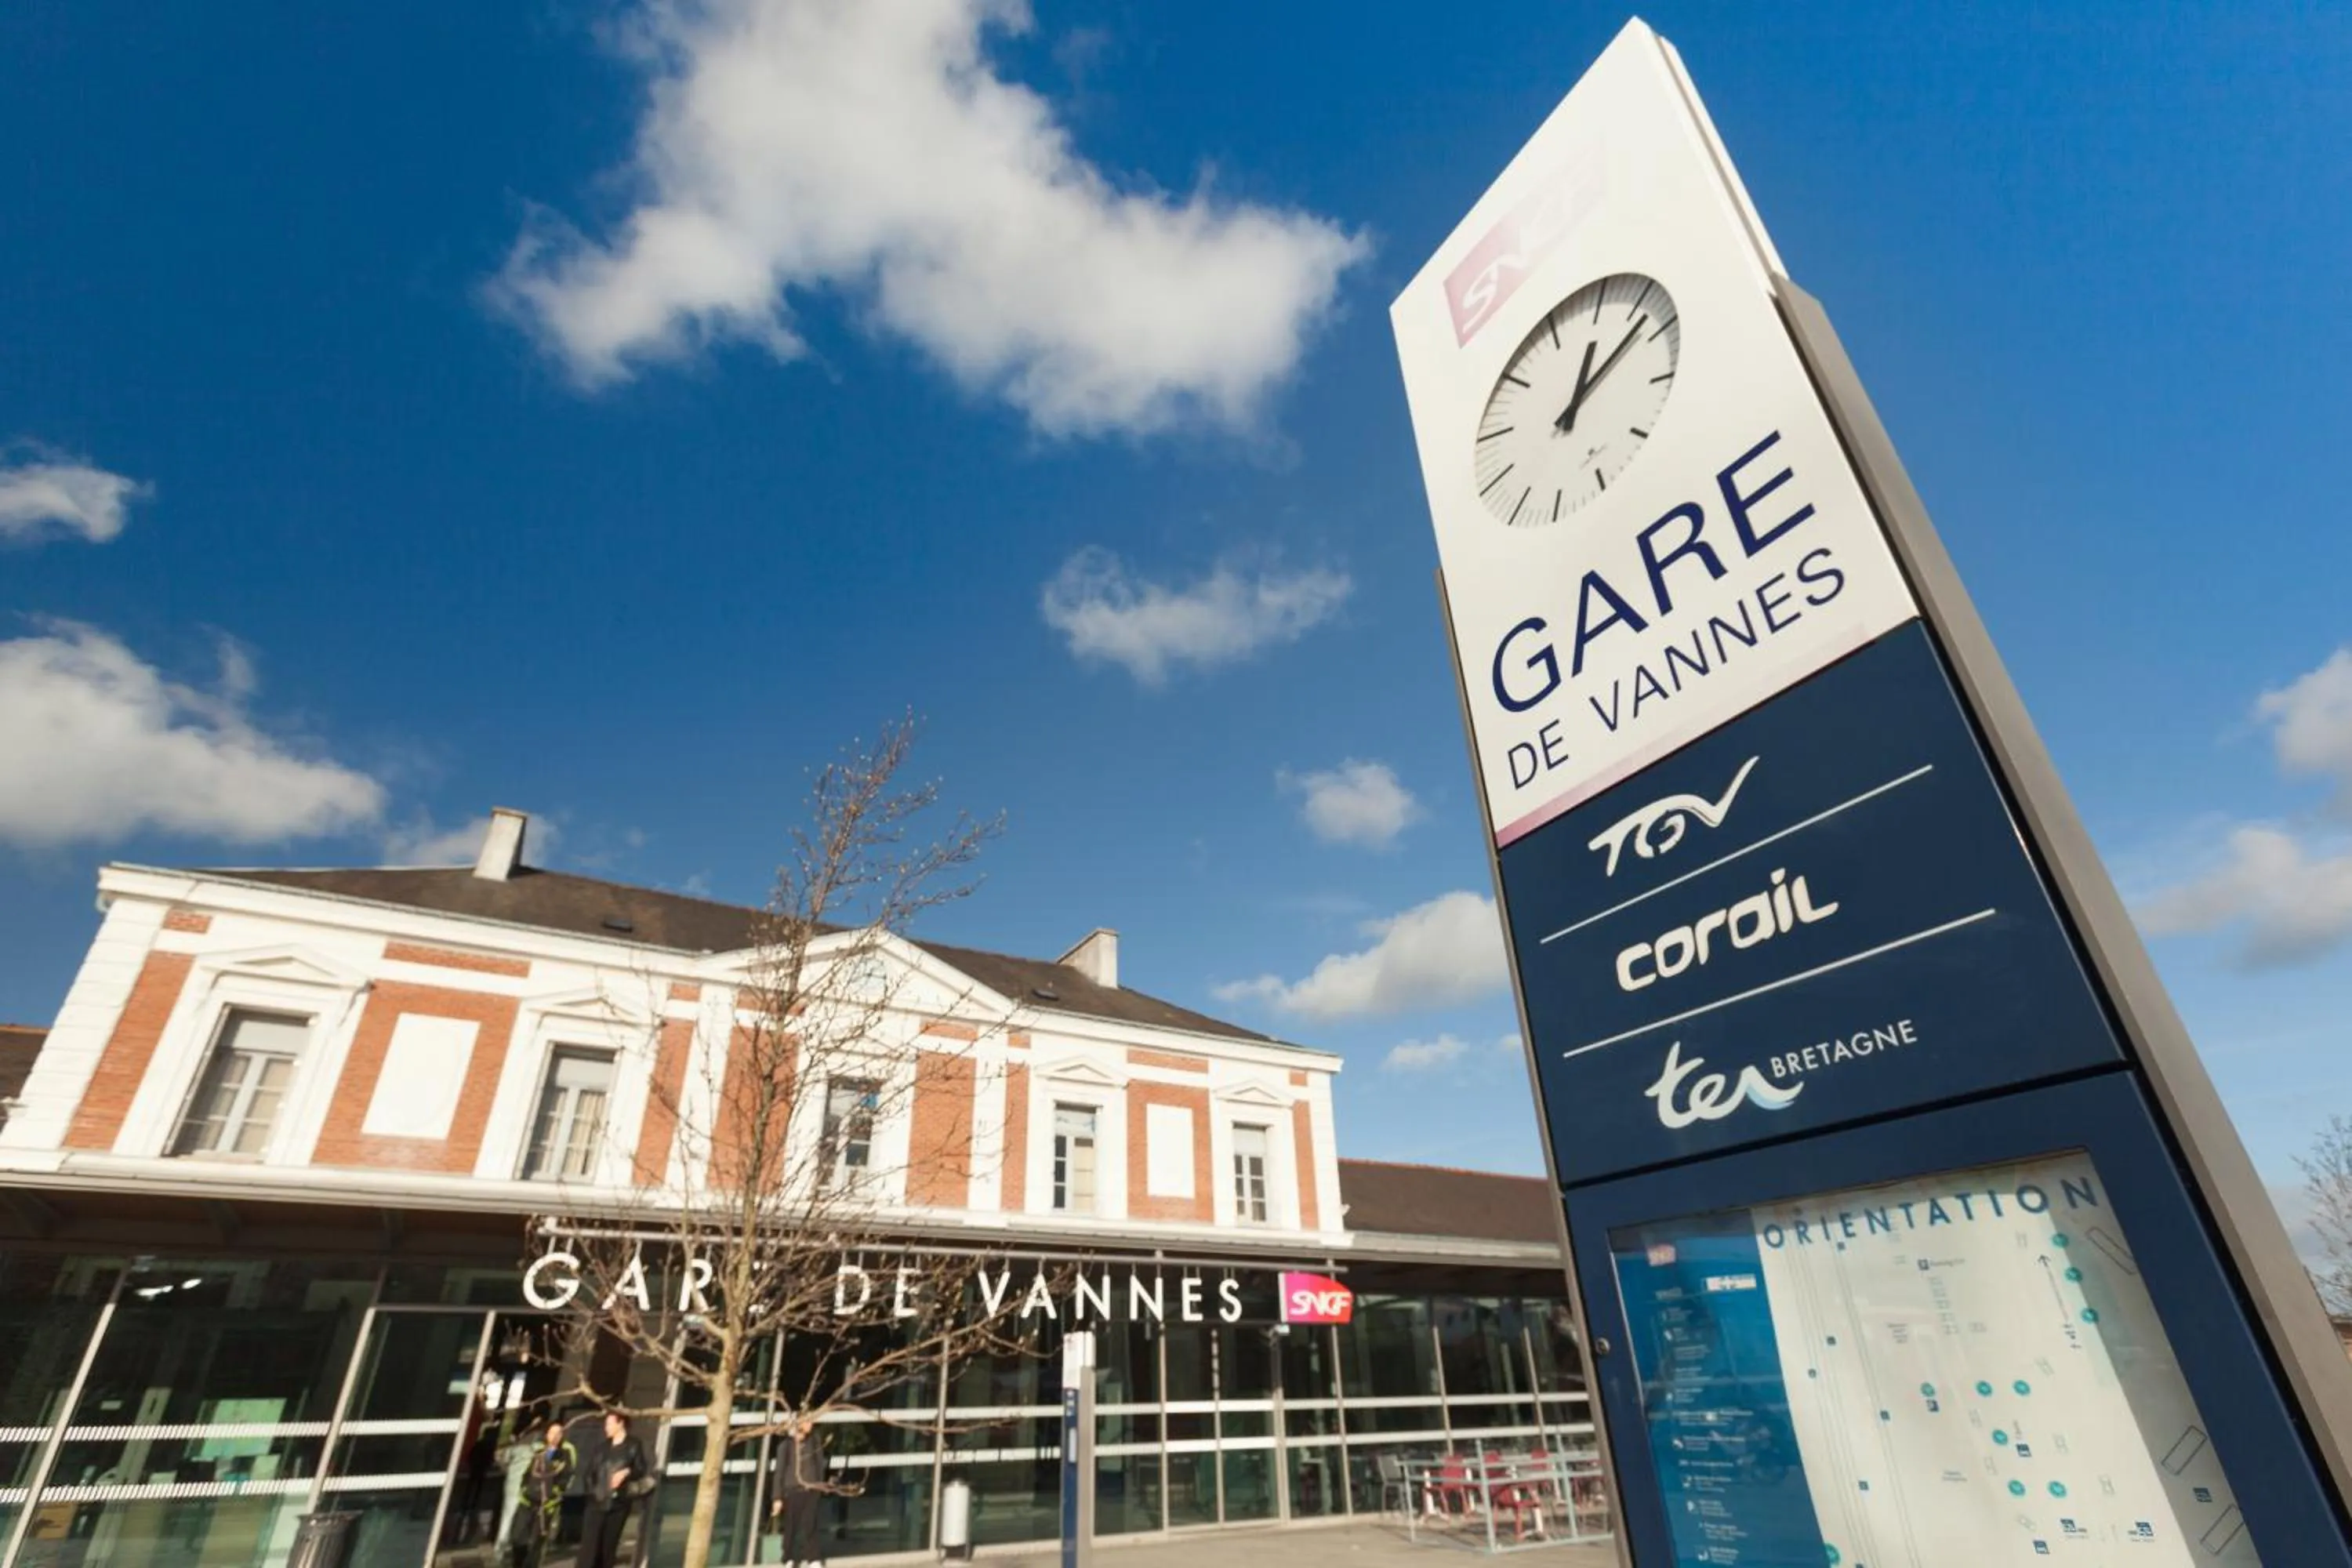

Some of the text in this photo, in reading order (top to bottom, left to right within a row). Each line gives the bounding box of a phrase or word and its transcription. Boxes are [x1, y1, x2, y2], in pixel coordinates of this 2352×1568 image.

[1492, 430, 1815, 713] GARE
[1508, 548, 1845, 790] DE VANNES
[1588, 756, 1760, 877] TGV
[1645, 1019, 1918, 1129] ter BRETAGNE
[1763, 1177, 2098, 1249] ORIENTATION
[523, 1253, 1243, 1323] GAR DE VANNES
[1290, 1290, 1352, 1316] SNCF
